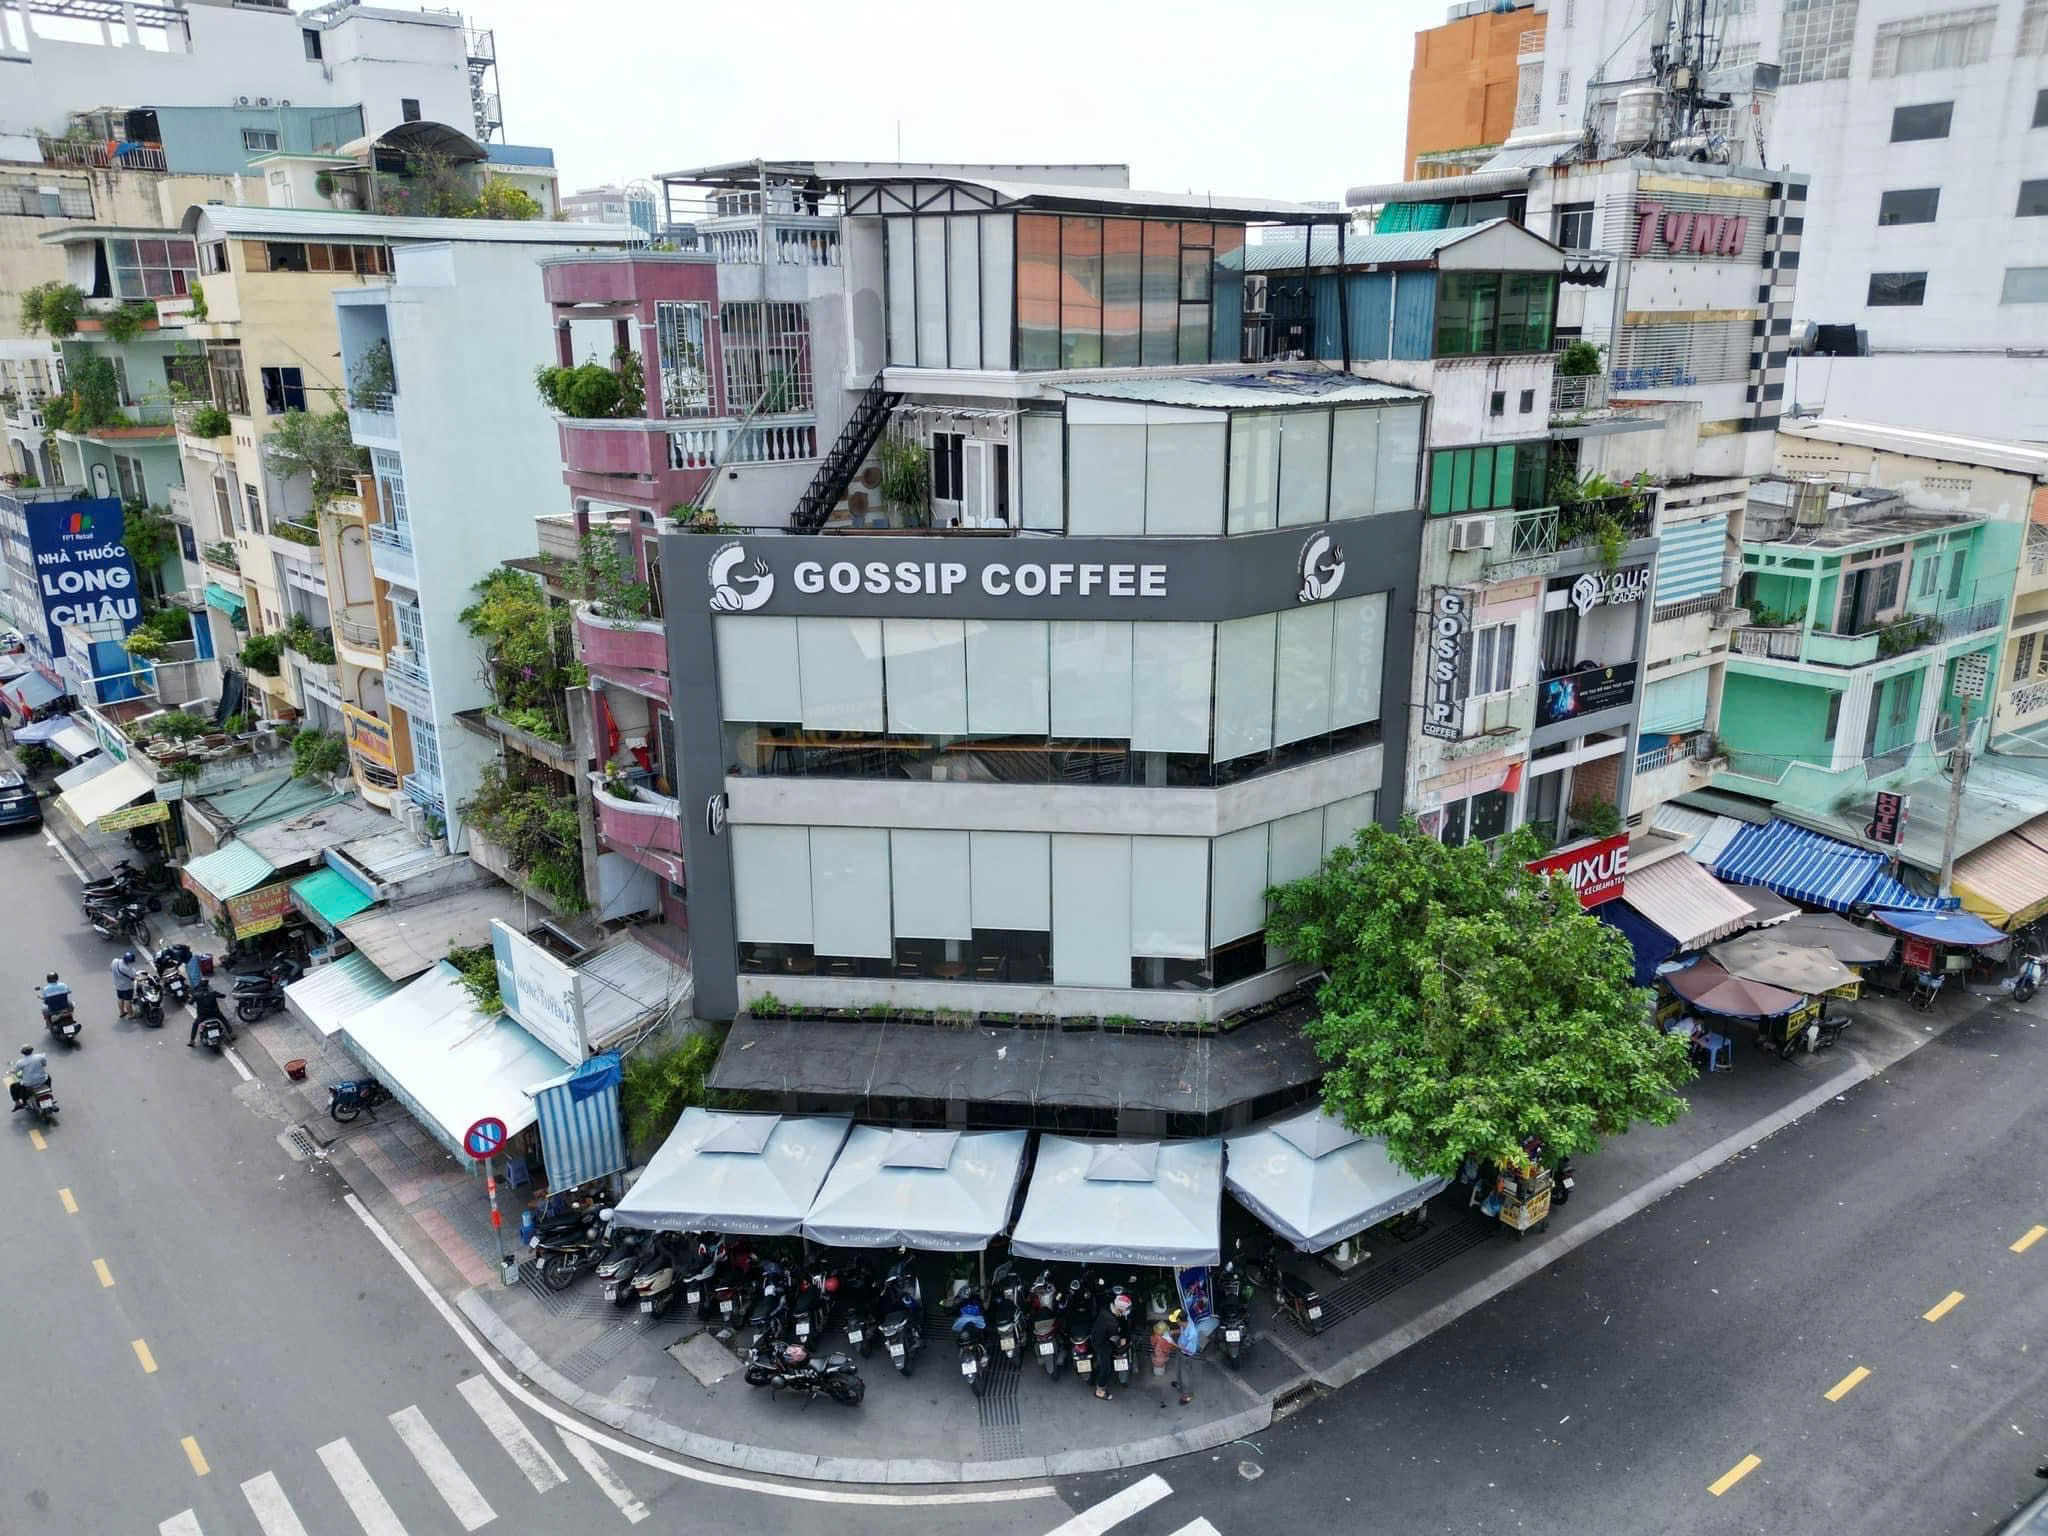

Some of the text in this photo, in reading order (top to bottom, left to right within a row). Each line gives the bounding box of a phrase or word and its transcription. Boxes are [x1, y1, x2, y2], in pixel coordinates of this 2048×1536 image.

[1636, 201, 1749, 257] TYNA
[38, 541, 126, 566] NHÀ THUỐC
[41, 566, 131, 596] LONG
[794, 562, 1168, 596] GOSSIP COFFEE
[1600, 569, 1649, 594] YOUR
[50, 595, 138, 627] CHÂU
[1607, 590, 1647, 606] ACADEMY
[1433, 594, 1463, 722] GOSSIP
[1423, 724, 1458, 739] COFFEE
[1875, 793, 1899, 844] HOTEL
